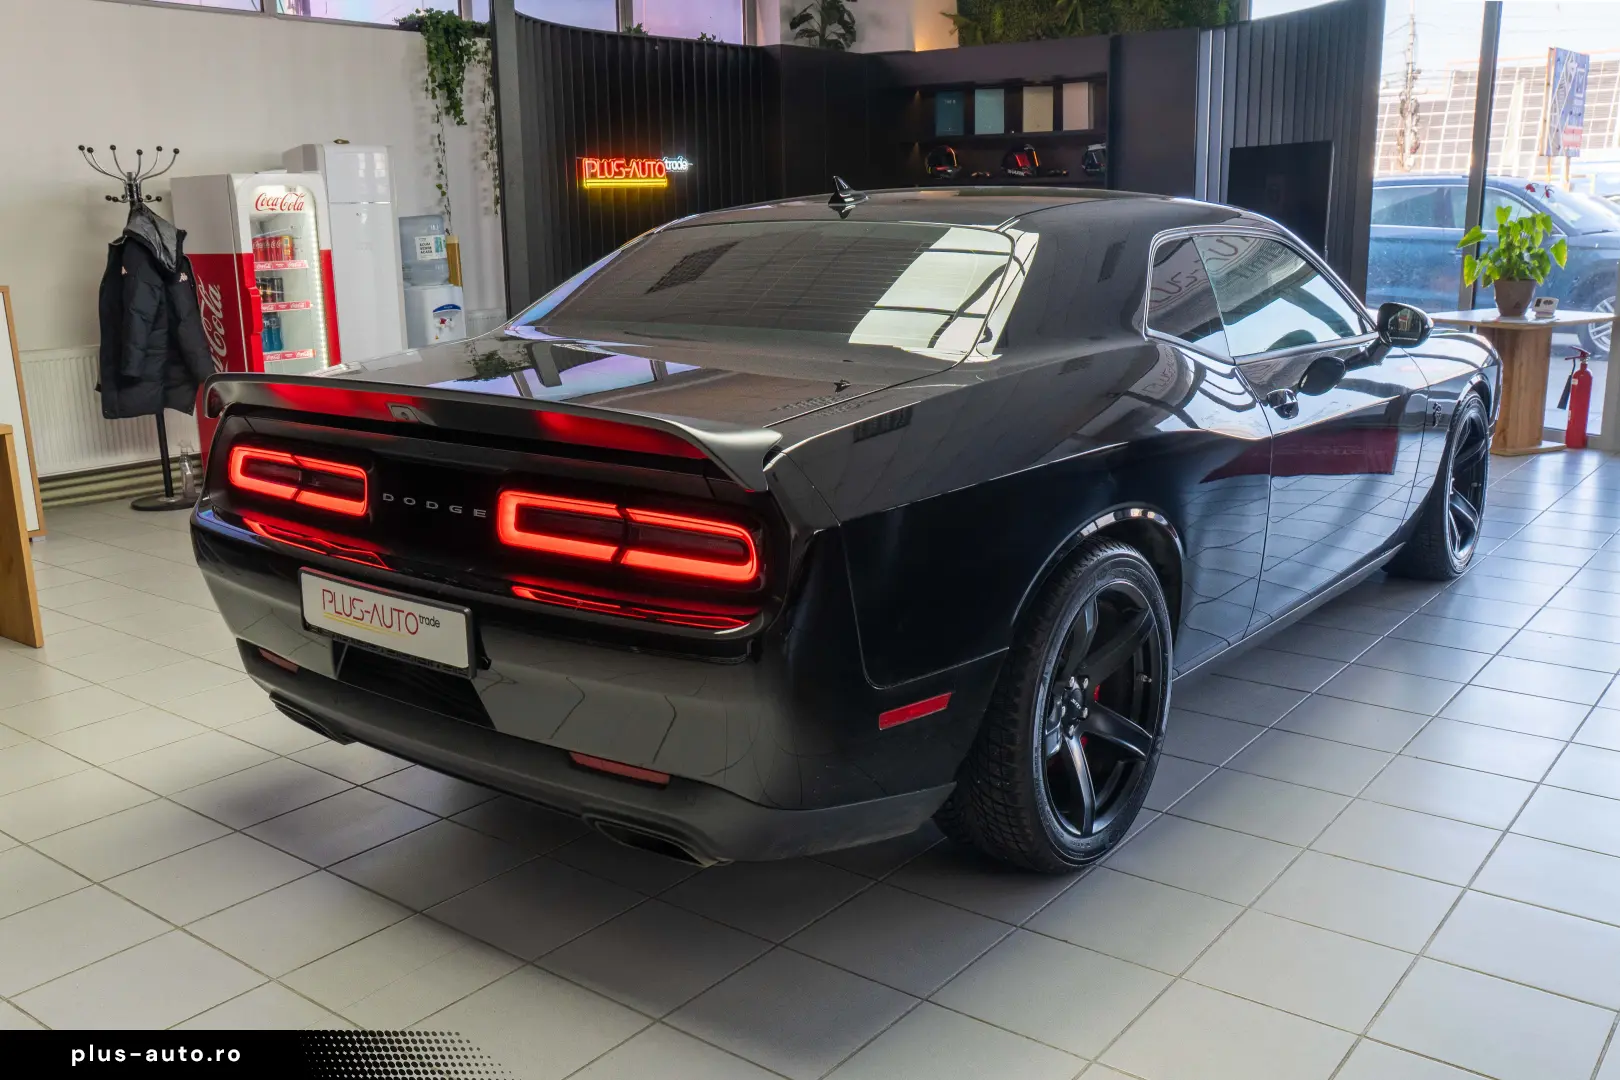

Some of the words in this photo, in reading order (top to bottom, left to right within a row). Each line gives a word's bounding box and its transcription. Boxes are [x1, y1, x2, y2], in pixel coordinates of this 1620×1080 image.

[585, 159, 666, 179] PLUS-AUTO
[255, 192, 306, 211] Coca-Cola
[382, 493, 487, 518] DODGE
[322, 588, 419, 635] PLUS-AUTO
[418, 613, 441, 628] trade
